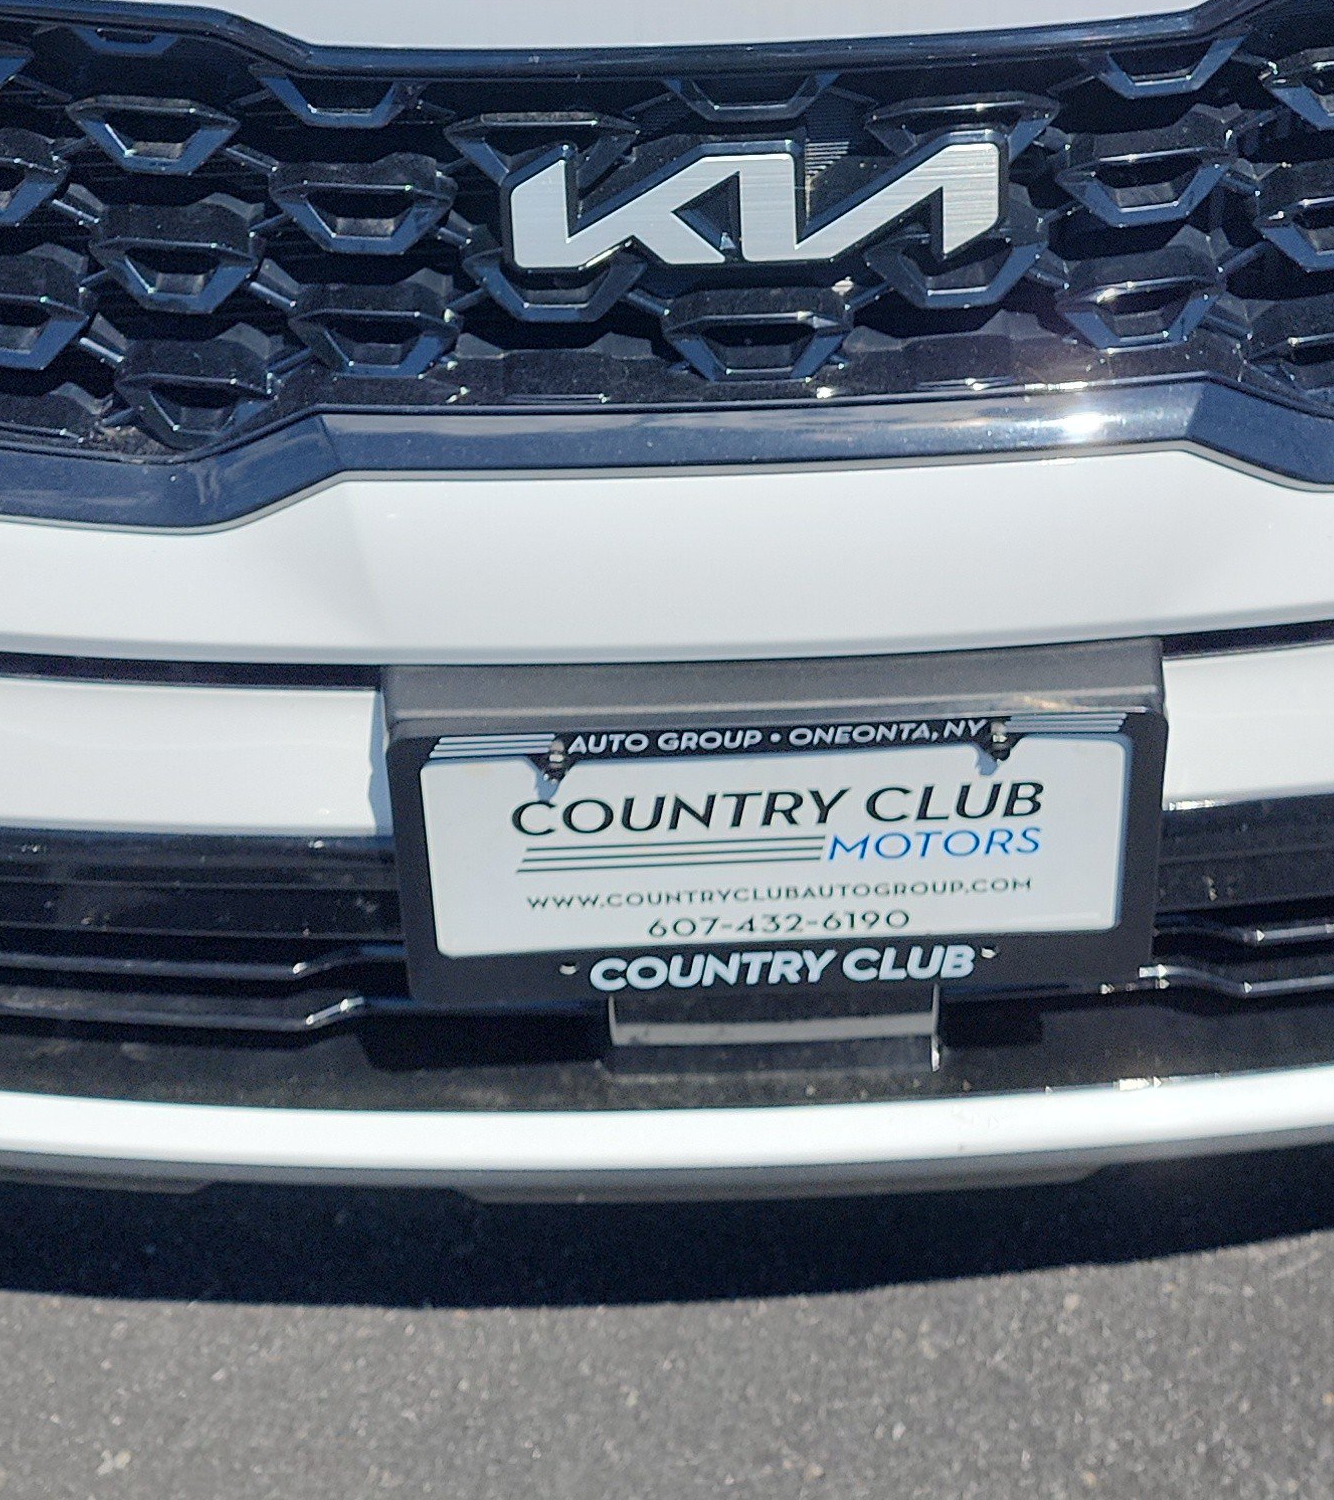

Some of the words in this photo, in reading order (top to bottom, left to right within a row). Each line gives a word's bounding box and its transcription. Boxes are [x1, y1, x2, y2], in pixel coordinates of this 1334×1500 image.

[510, 142, 1000, 269] KIA
[567, 732, 649, 755] AUTO
[657, 729, 763, 751] GROUP
[511, 787, 850, 837] COUNTRY
[866, 781, 1045, 823] CLUB
[829, 826, 1043, 861] MOTORS
[526, 876, 1033, 910] WWW.COUNTRYCLUBAUTOGROUP.COM
[648, 909, 911, 938] 607-432-6190
[589, 948, 838, 991] COUNTRY
[841, 944, 976, 982] CLUB
